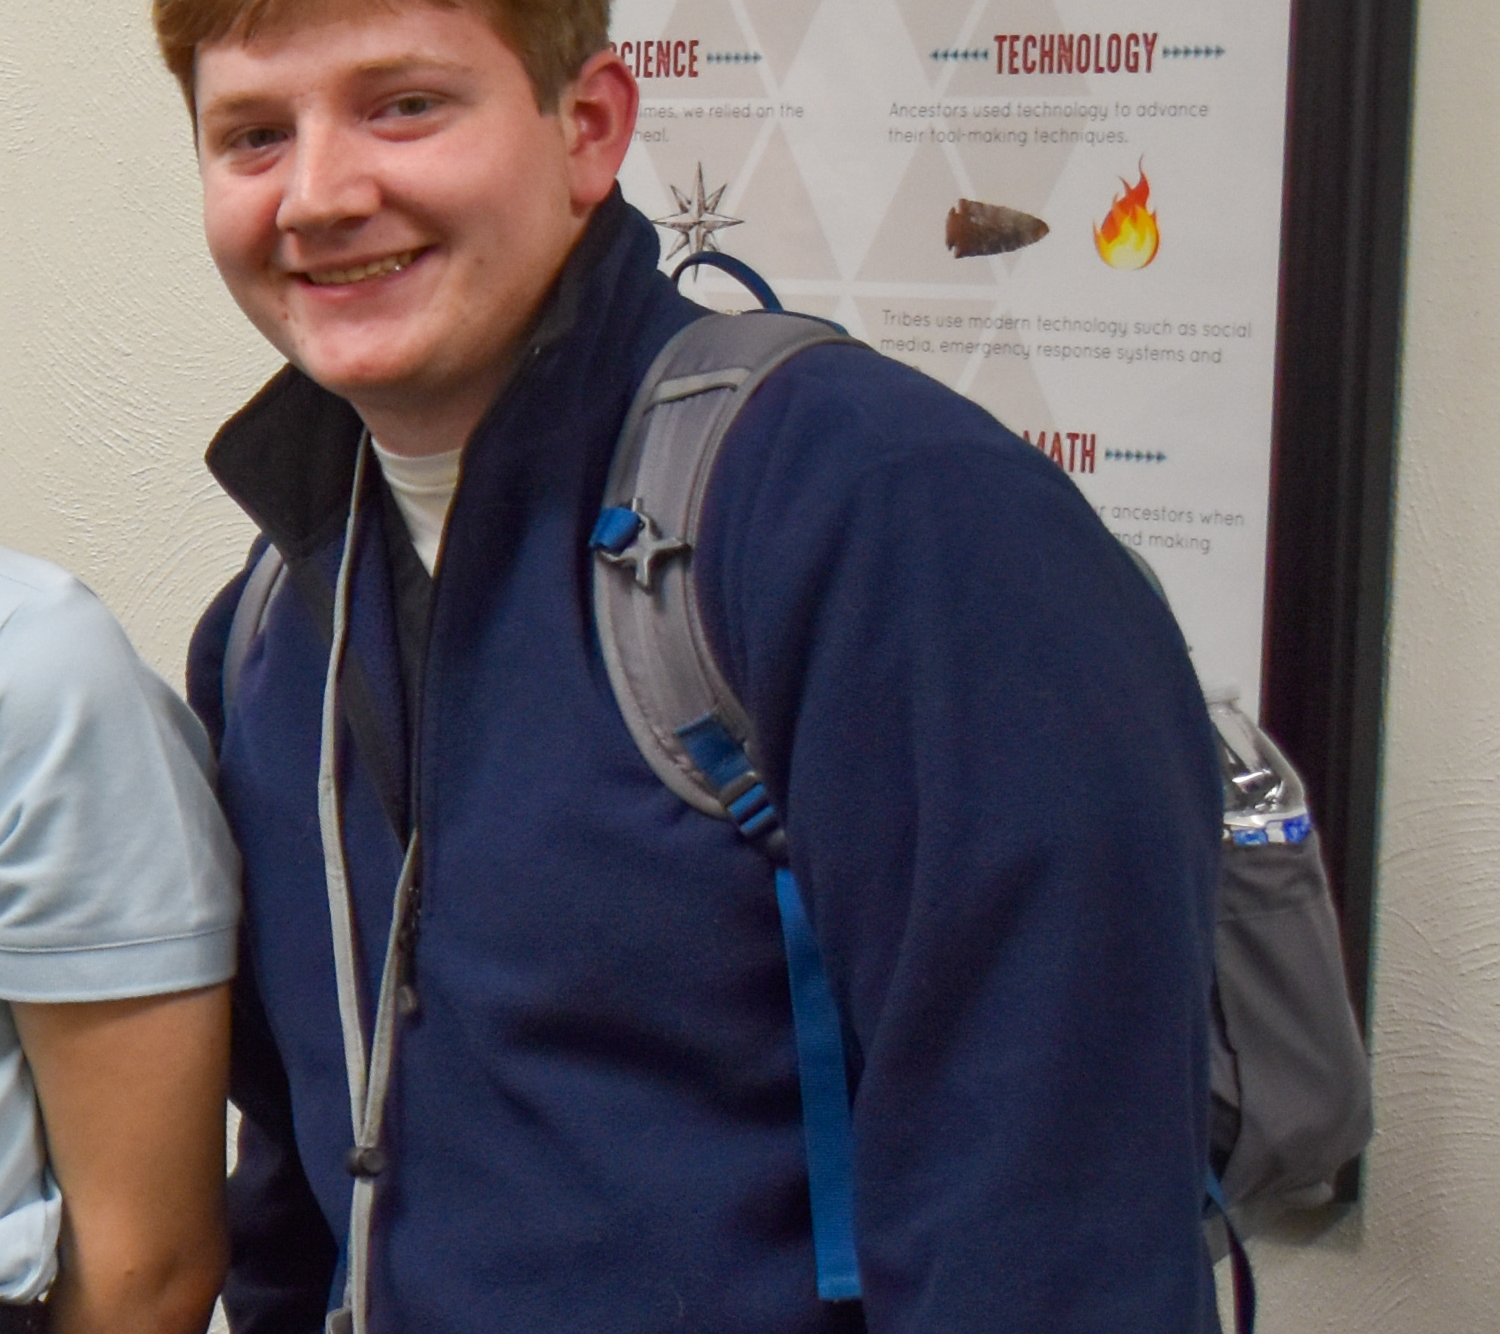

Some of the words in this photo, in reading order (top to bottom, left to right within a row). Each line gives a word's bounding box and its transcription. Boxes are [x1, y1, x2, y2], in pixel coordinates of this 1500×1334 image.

[994, 32, 1158, 74] TECHNOLOGY
[889, 102, 968, 118] Ancestors
[973, 102, 1010, 117] used
[1017, 102, 1109, 121] technology
[1136, 101, 1209, 117] advance
[889, 128, 924, 143] their
[930, 127, 1028, 147] tool-making
[882, 309, 930, 328] Tribes
[968, 314, 1031, 330] modern
[1036, 315, 1128, 338] technology
[1133, 319, 1172, 336] such
[1202, 321, 1252, 339] social
[939, 341, 1031, 359] emergency
[1037, 344, 1111, 363] response
[1117, 346, 1185, 364] systems
[1190, 348, 1222, 364] and
[1112, 505, 1194, 524] ancestors
[1200, 511, 1245, 527] when
[1148, 533, 1211, 554] making
